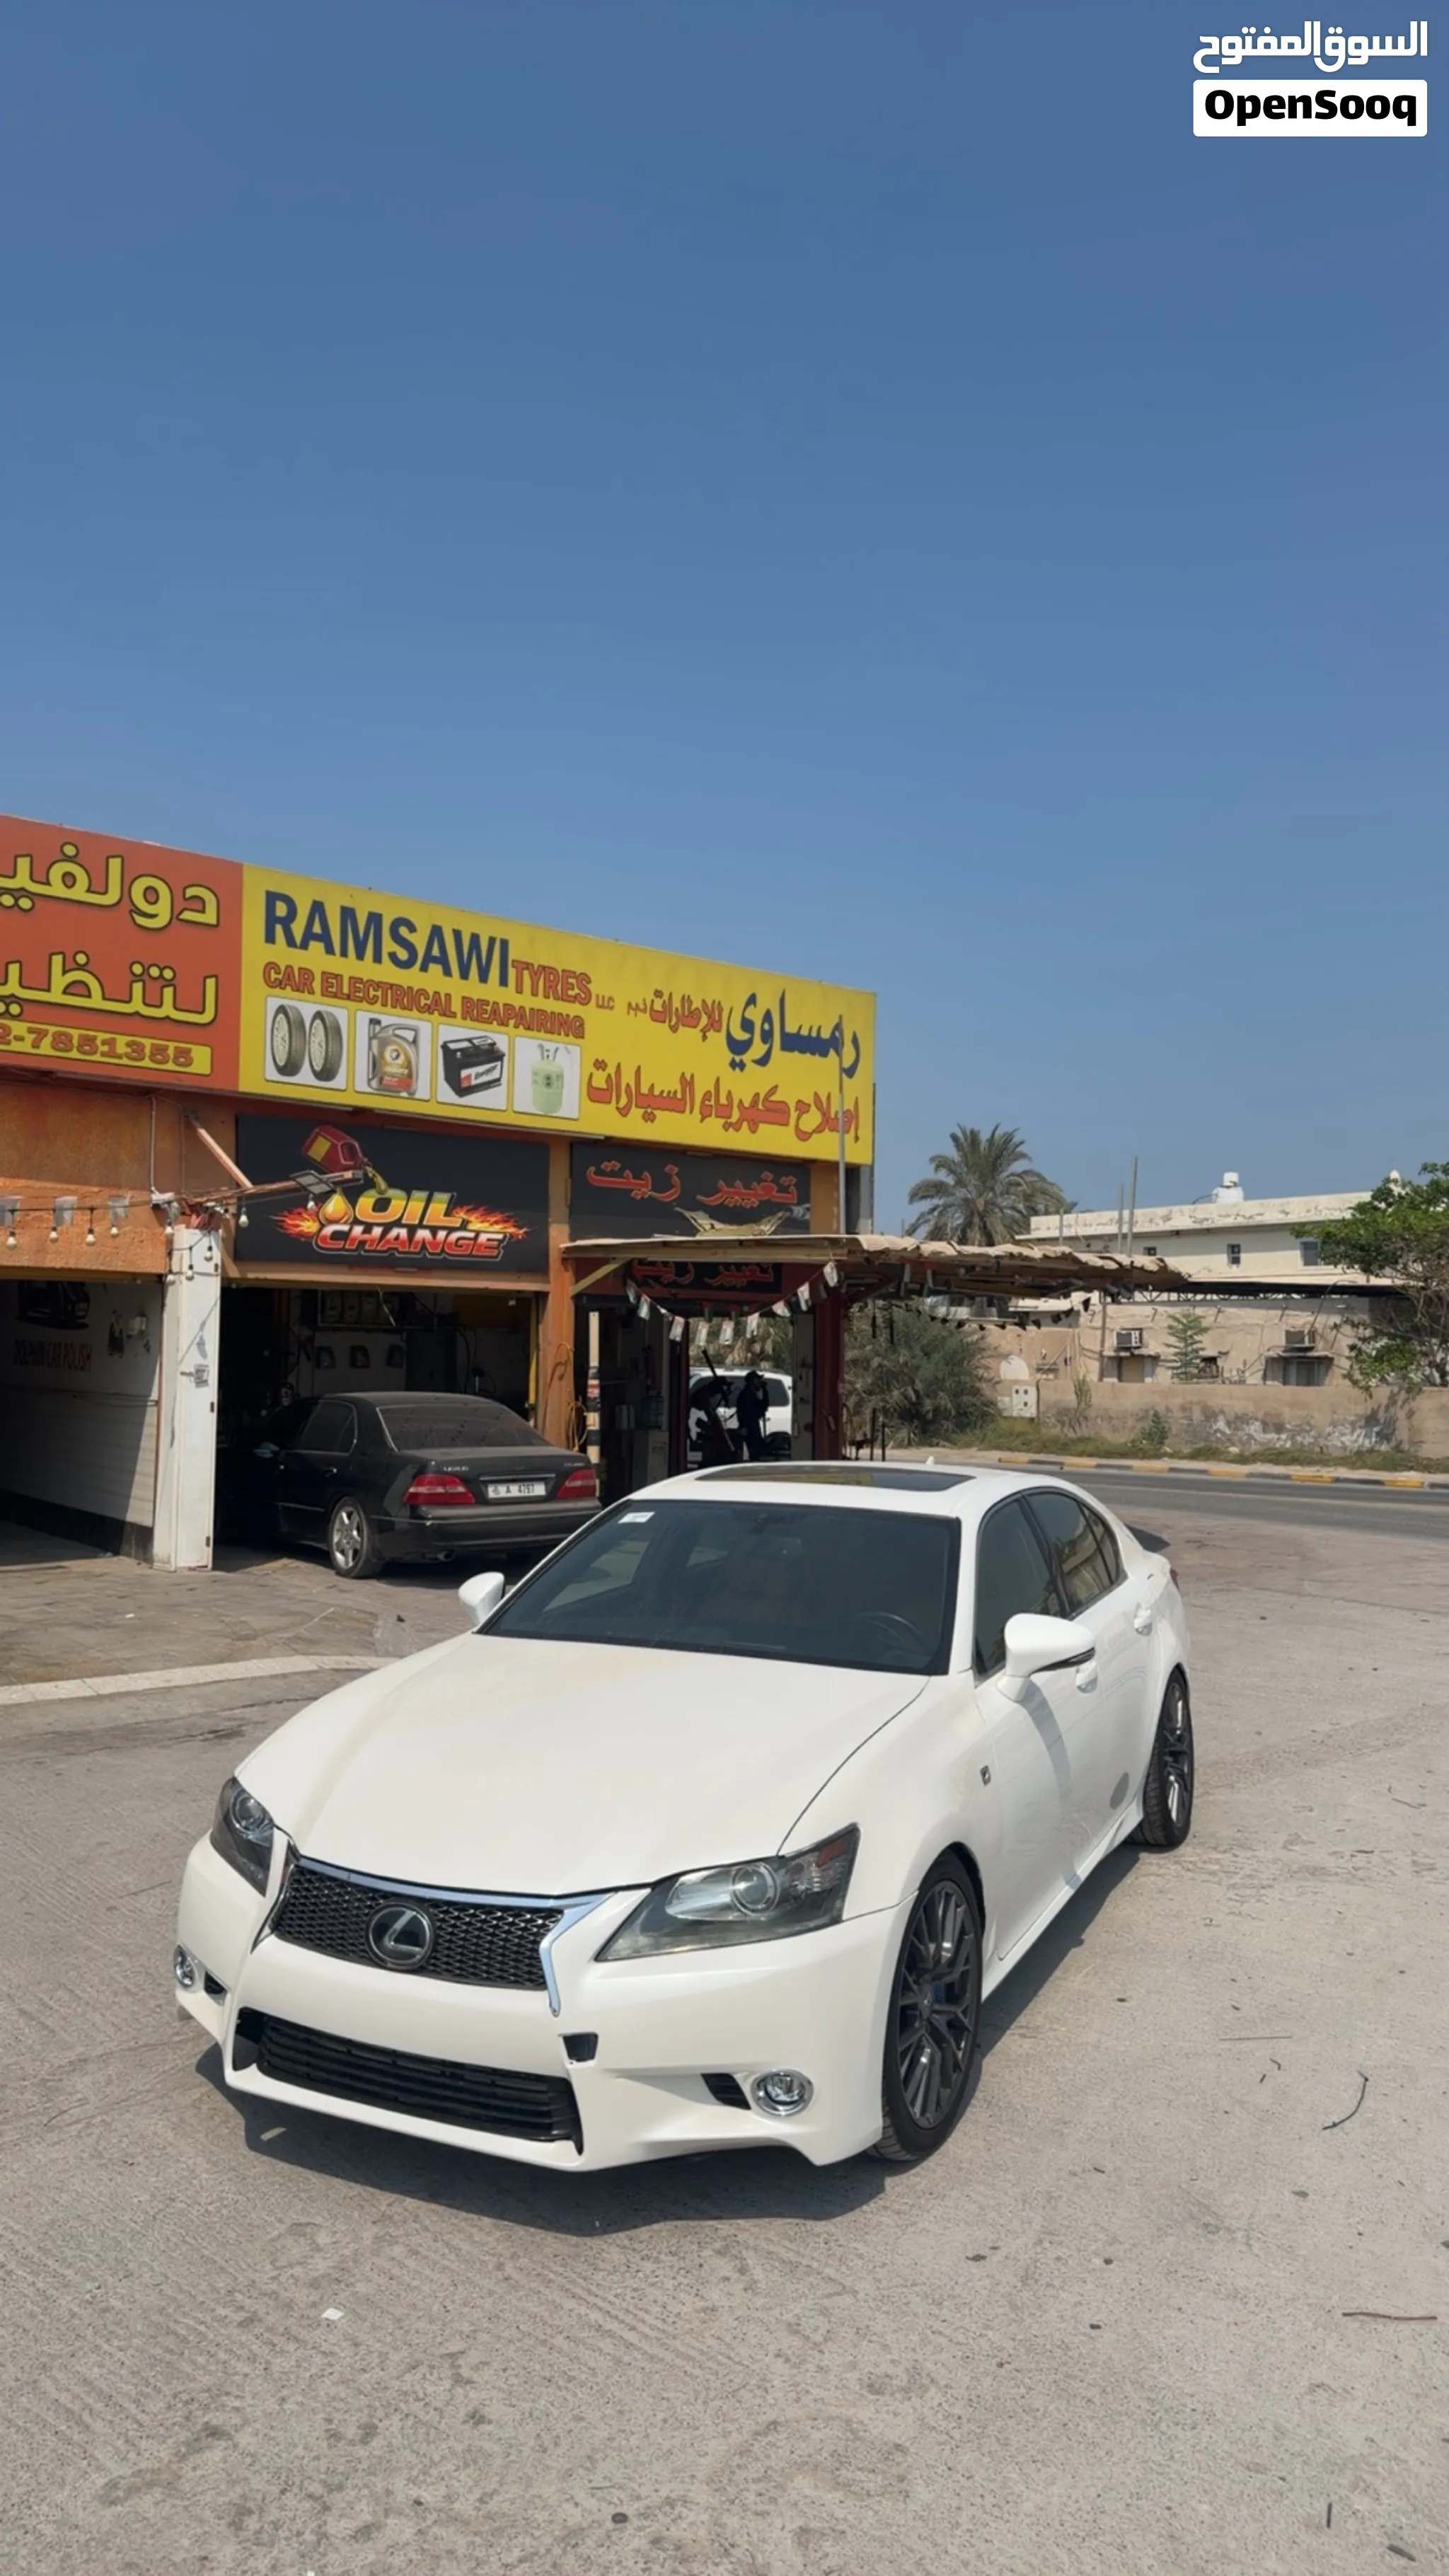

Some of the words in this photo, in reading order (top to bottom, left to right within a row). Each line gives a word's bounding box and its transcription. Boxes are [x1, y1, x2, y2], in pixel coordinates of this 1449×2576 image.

[265, 889, 509, 987] RAMSAWI
[512, 959, 592, 1006] TYRES
[595, 993, 615, 1011] LLC
[262, 961, 315, 995] CAR
[321, 971, 456, 1018] ELECTRICAL
[461, 996, 585, 1039] REAPAIRING
[648, 988, 724, 1042] للإطارات
[725, 988, 861, 1080] رمساوي
[586, 1058, 695, 1124] السيارات
[698, 1076, 791, 1133] كهرباء
[794, 1090, 861, 1143] إصلاح
[354, 1188, 464, 1228] OIL
[585, 1160, 682, 1202] زيت
[696, 1171, 798, 1209] تغيير
[316, 1224, 509, 1258] CHANGE
